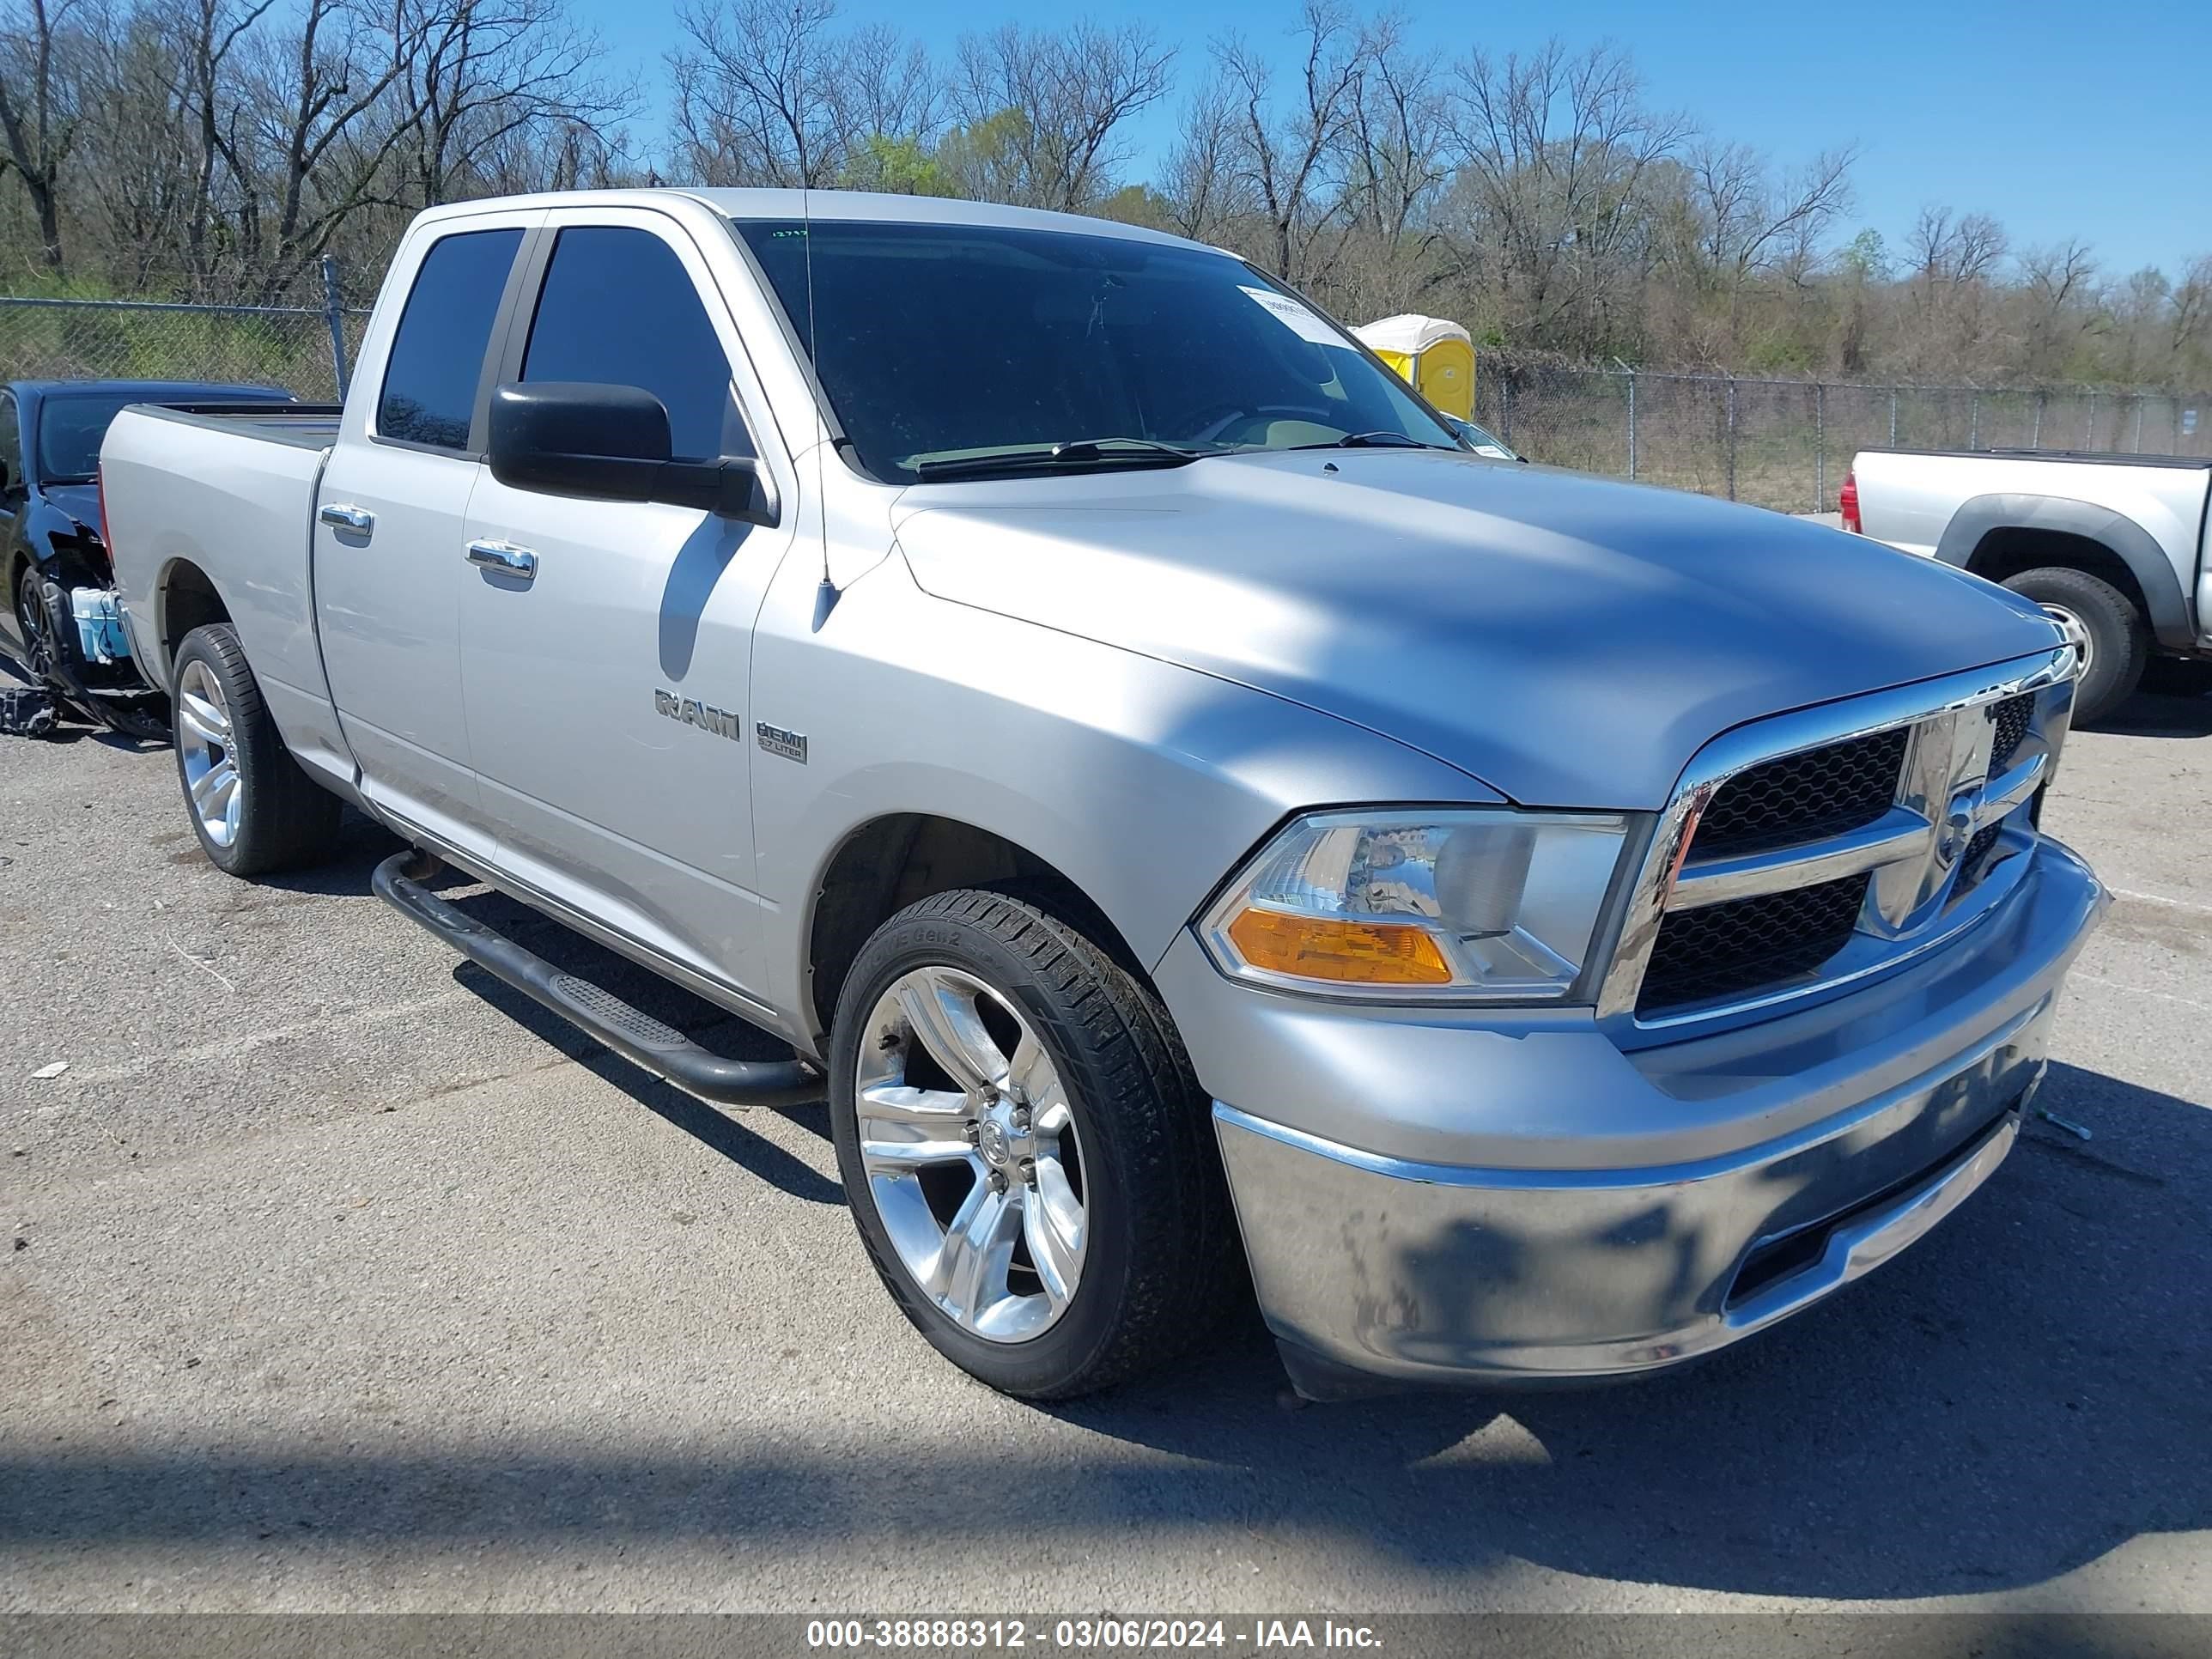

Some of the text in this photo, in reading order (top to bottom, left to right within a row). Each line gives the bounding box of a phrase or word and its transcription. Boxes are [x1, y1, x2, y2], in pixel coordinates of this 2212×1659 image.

[654, 686, 739, 743] RAM
[756, 720, 808, 750] HEMI
[775, 743, 801, 757] LITER
[913, 927, 961, 947] Gen2
